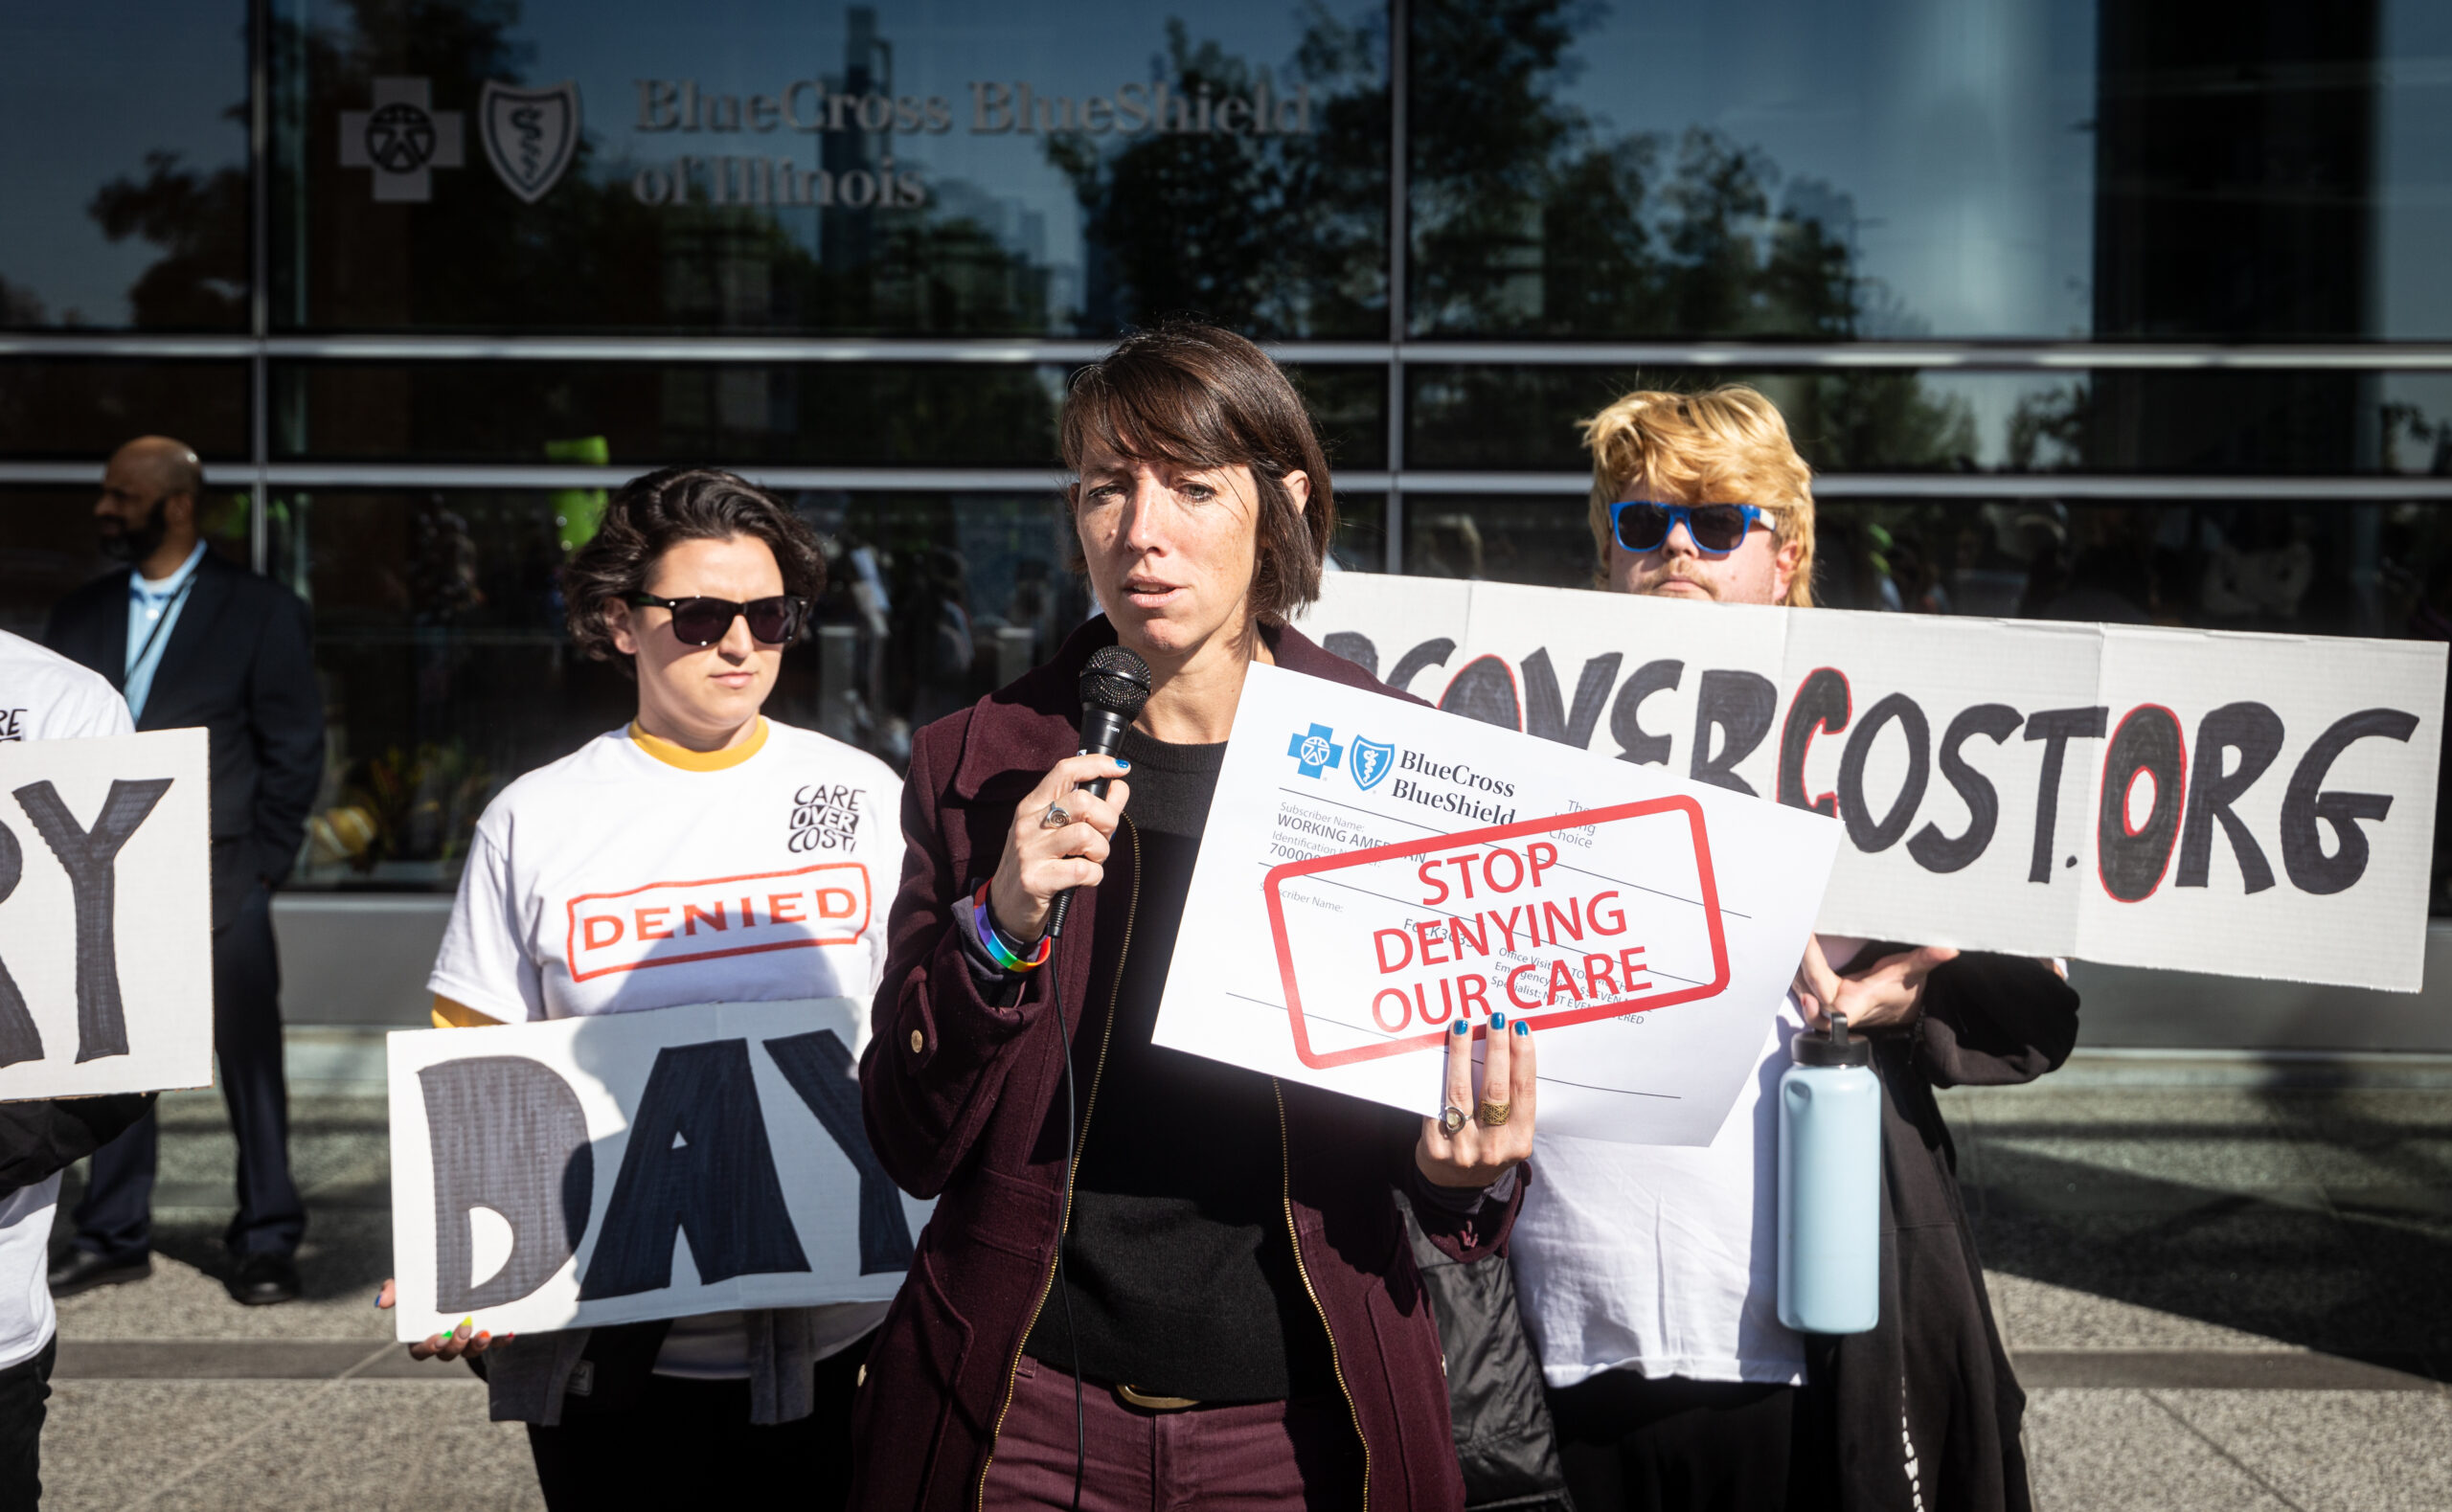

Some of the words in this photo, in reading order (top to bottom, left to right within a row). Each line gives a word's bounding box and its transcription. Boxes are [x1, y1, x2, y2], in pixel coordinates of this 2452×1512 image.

[634, 78, 953, 133] BlueCross
[967, 79, 1310, 135] BlueShield
[631, 155, 704, 208] of
[714, 155, 929, 210] Illinois
[1399, 749, 1515, 798] BlueCross
[793, 783, 867, 812] CARE
[1280, 801, 1332, 824] Subscriber
[1333, 816, 1365, 832] Name:
[1392, 779, 1516, 826] BlueShield
[791, 804, 858, 834] OVER
[1277, 813, 1347, 843] WORKING
[1271, 830, 1336, 855] Identification
[1418, 842, 1558, 906] STOP
[1259, 881, 1309, 904] Scriber
[1312, 896, 1345, 913] Name:
[583, 887, 857, 952] DENIED
[1373, 891, 1627, 975] DENYING
[1372, 974, 1492, 1033] OUR
[1506, 946, 1652, 1009] CARE
[1490, 975, 1541, 999] Speialist:
[1494, 960, 1552, 987] Emgency
